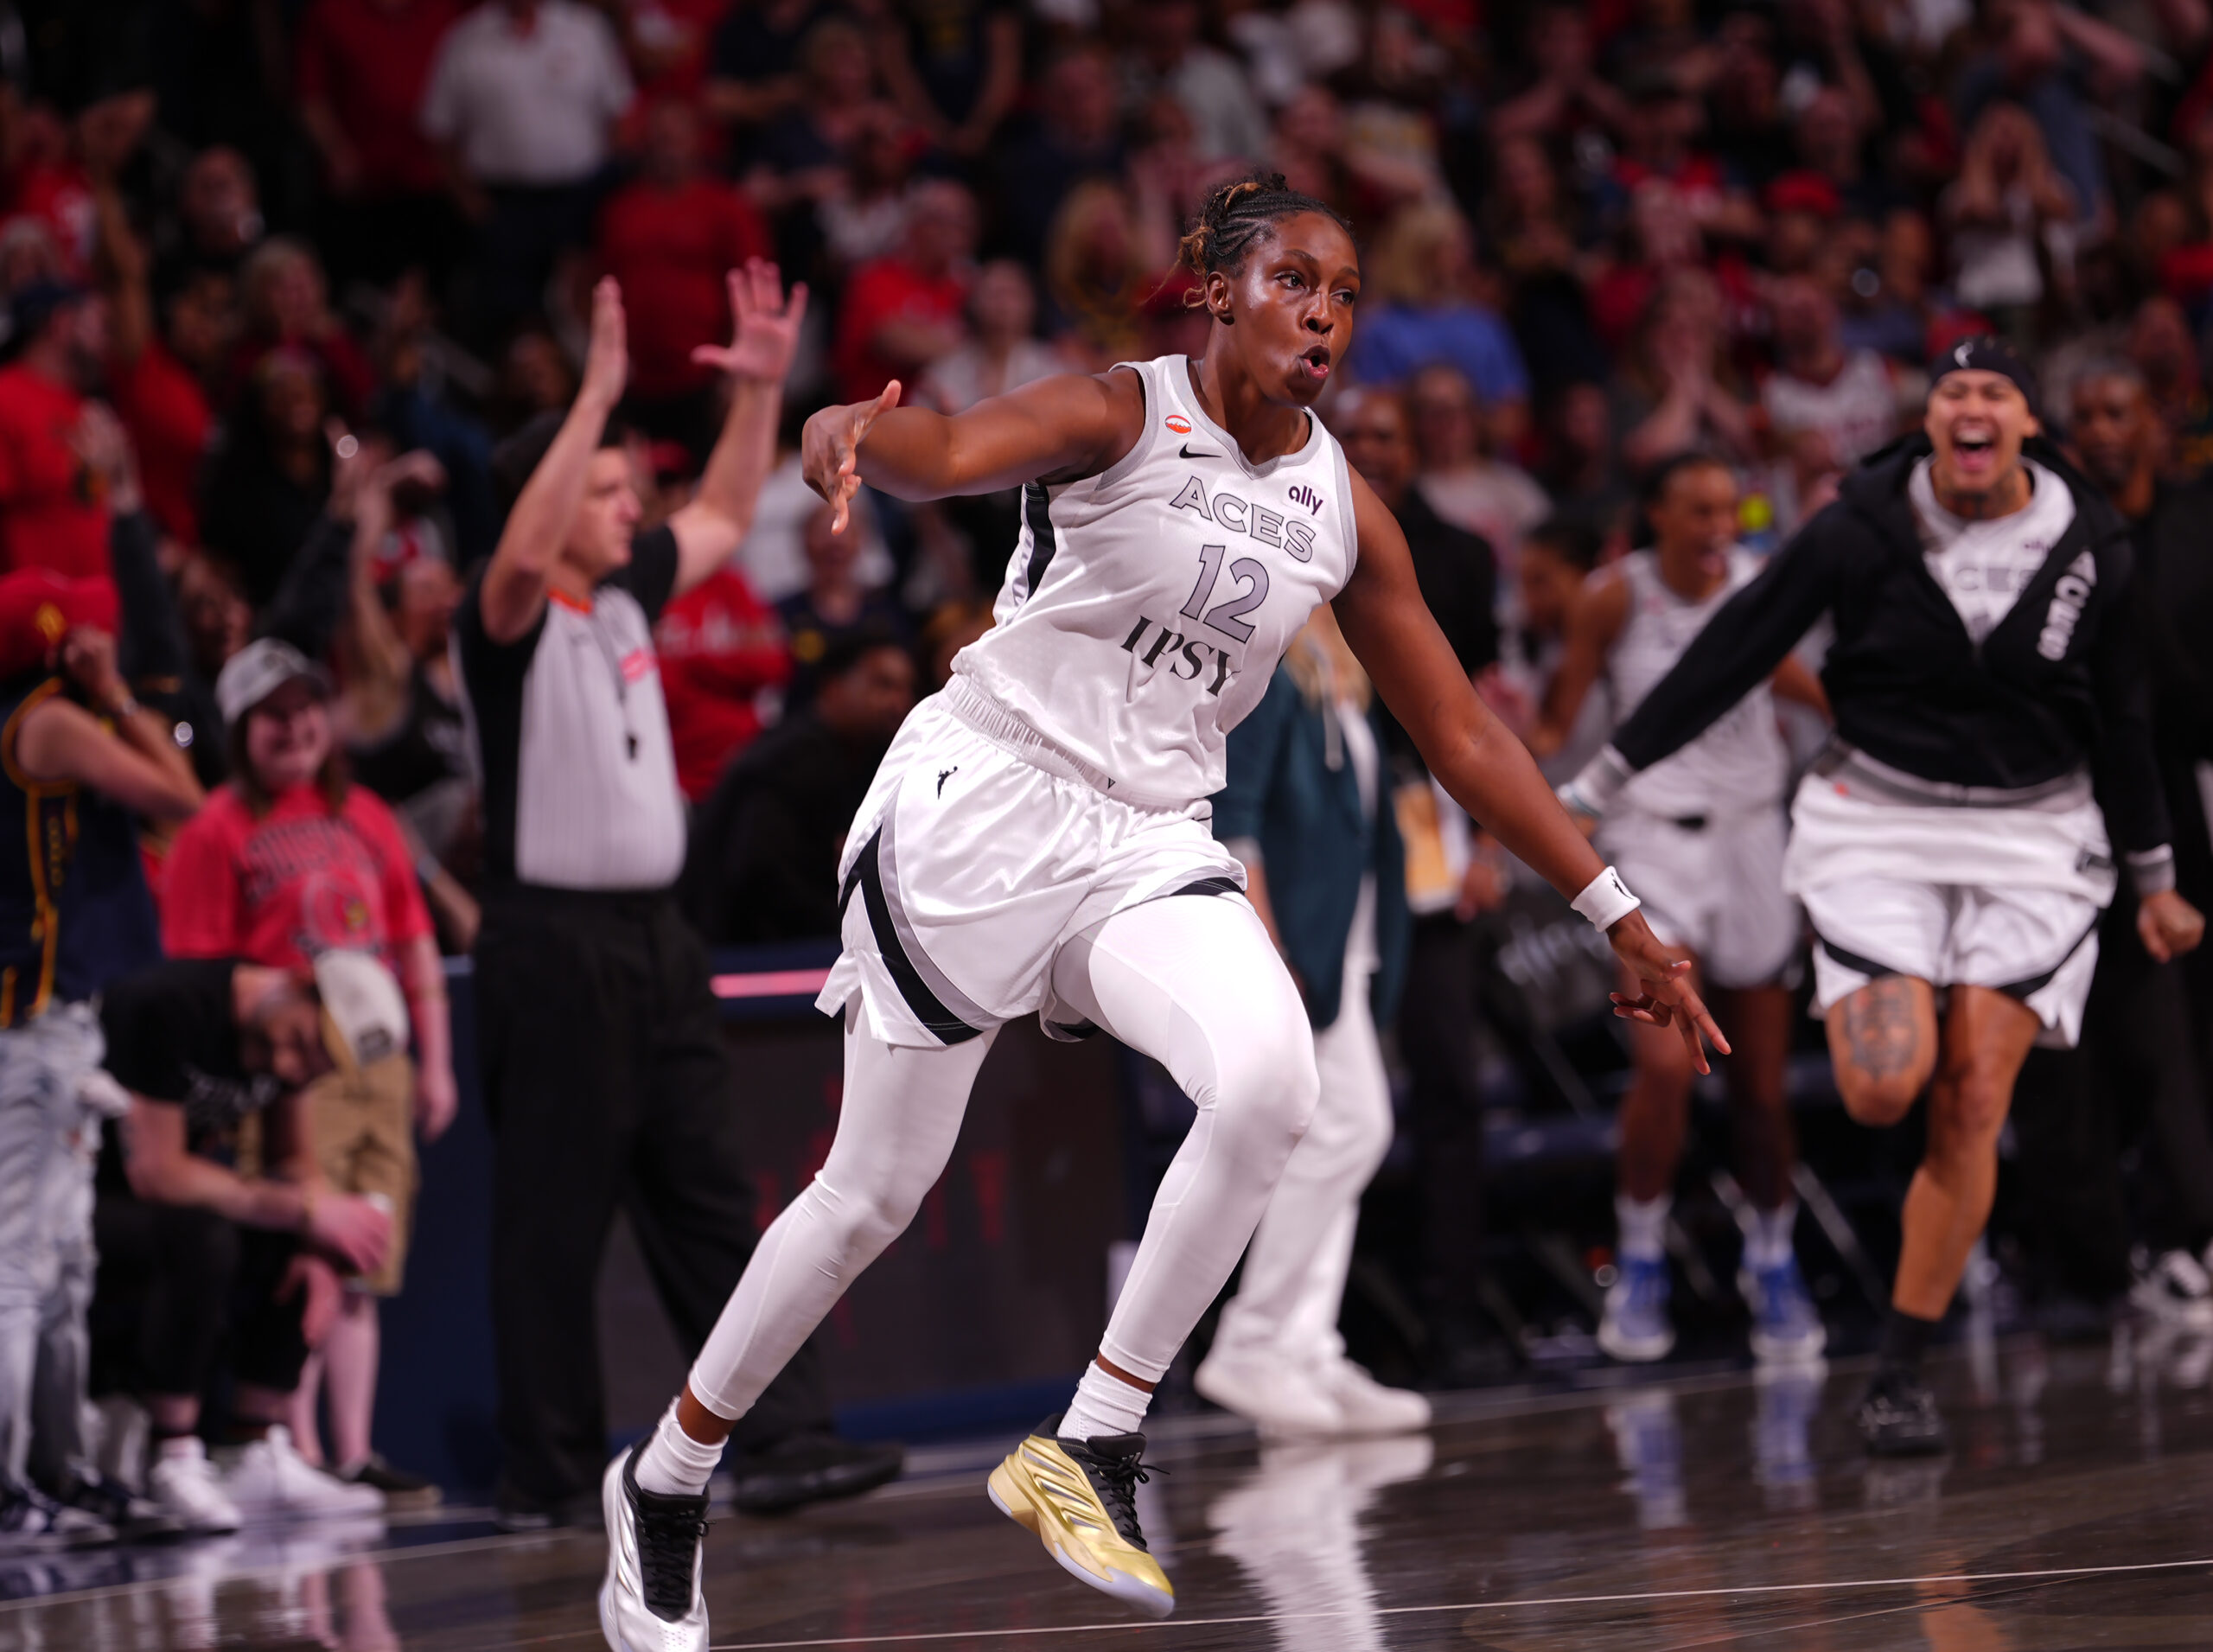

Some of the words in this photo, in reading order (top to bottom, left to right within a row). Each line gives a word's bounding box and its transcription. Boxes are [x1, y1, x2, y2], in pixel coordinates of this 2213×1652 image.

[1169, 475, 1317, 563] ACES
[1288, 485, 1323, 516] ally
[1179, 545, 1270, 644] 12
[1120, 616, 1241, 697] IPSY
